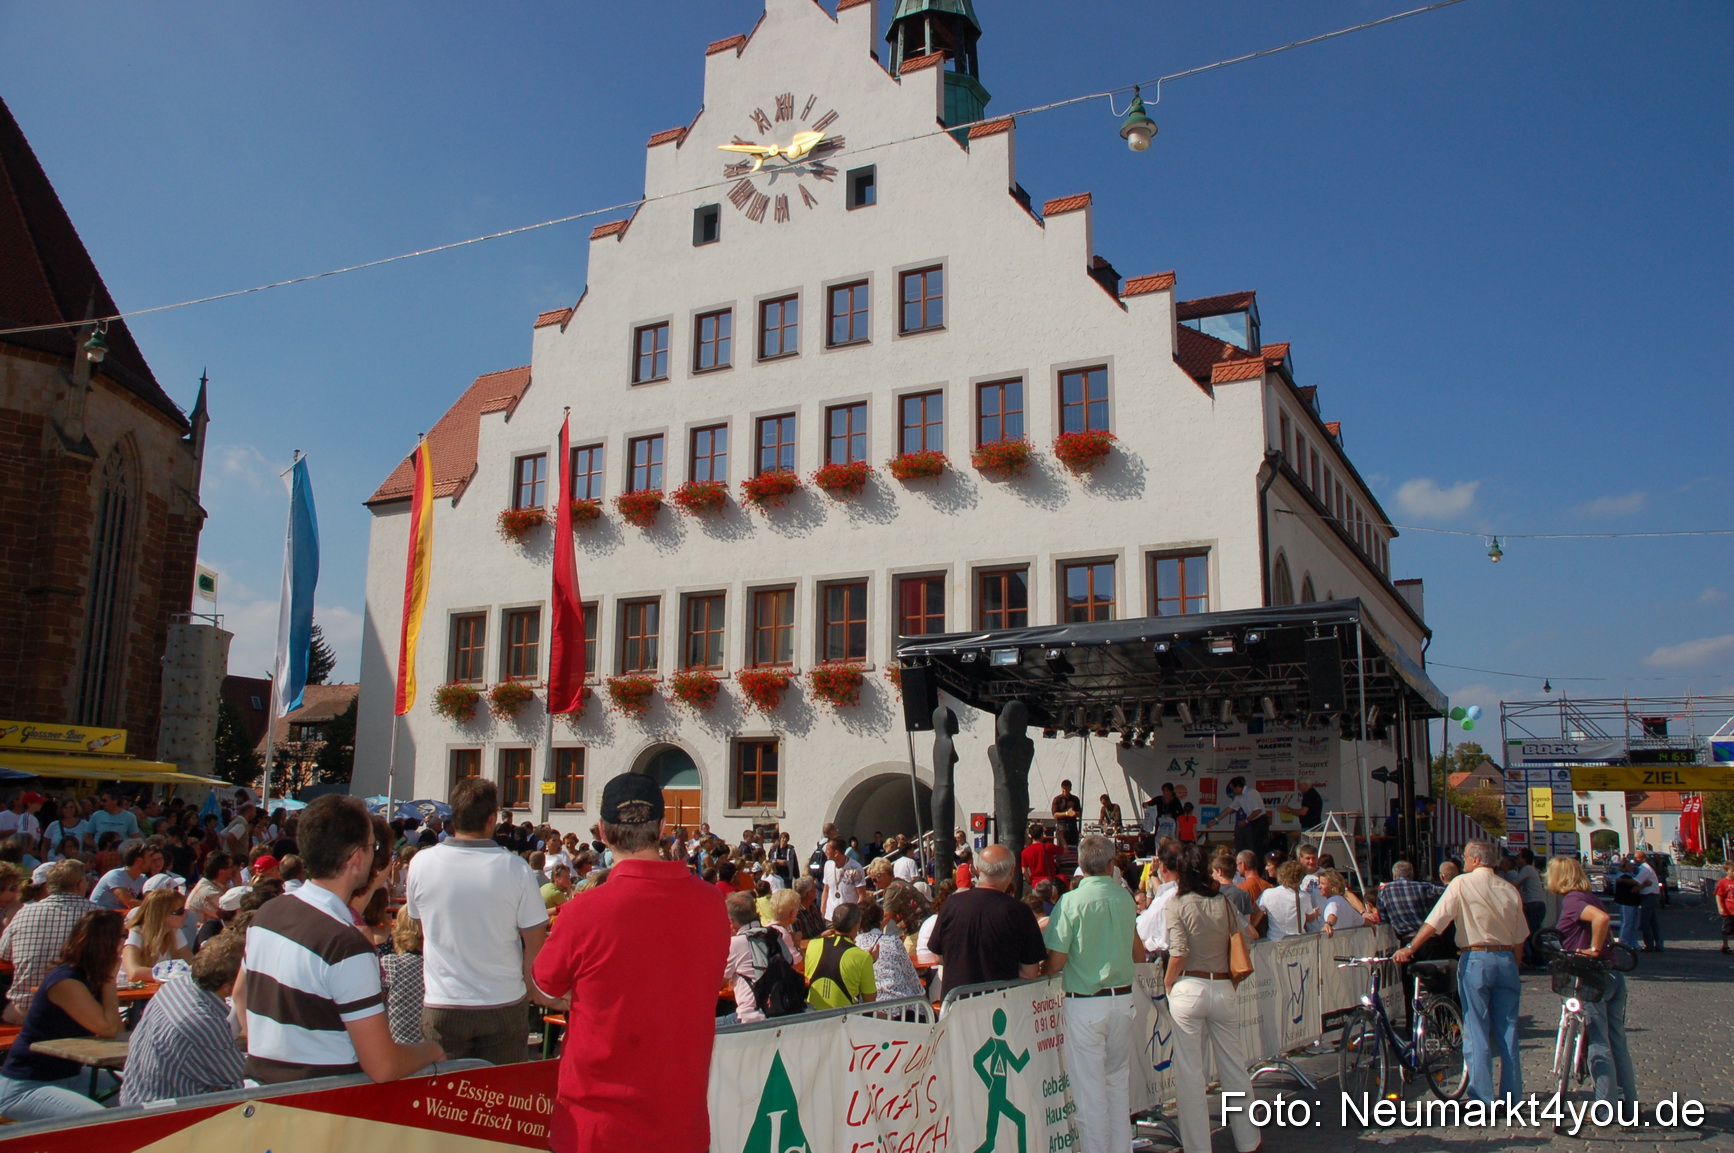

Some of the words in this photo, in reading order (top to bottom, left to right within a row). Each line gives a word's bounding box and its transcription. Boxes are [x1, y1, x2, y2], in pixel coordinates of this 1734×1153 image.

[1523, 744, 1579, 755] BOCK
[1643, 771, 1686, 785] ZIEL
[456, 1079, 504, 1108] Essige
[508, 1094, 533, 1111] und
[426, 1097, 468, 1122] Weine
[471, 1107, 512, 1131] frisch
[517, 1120, 545, 1137] vom
